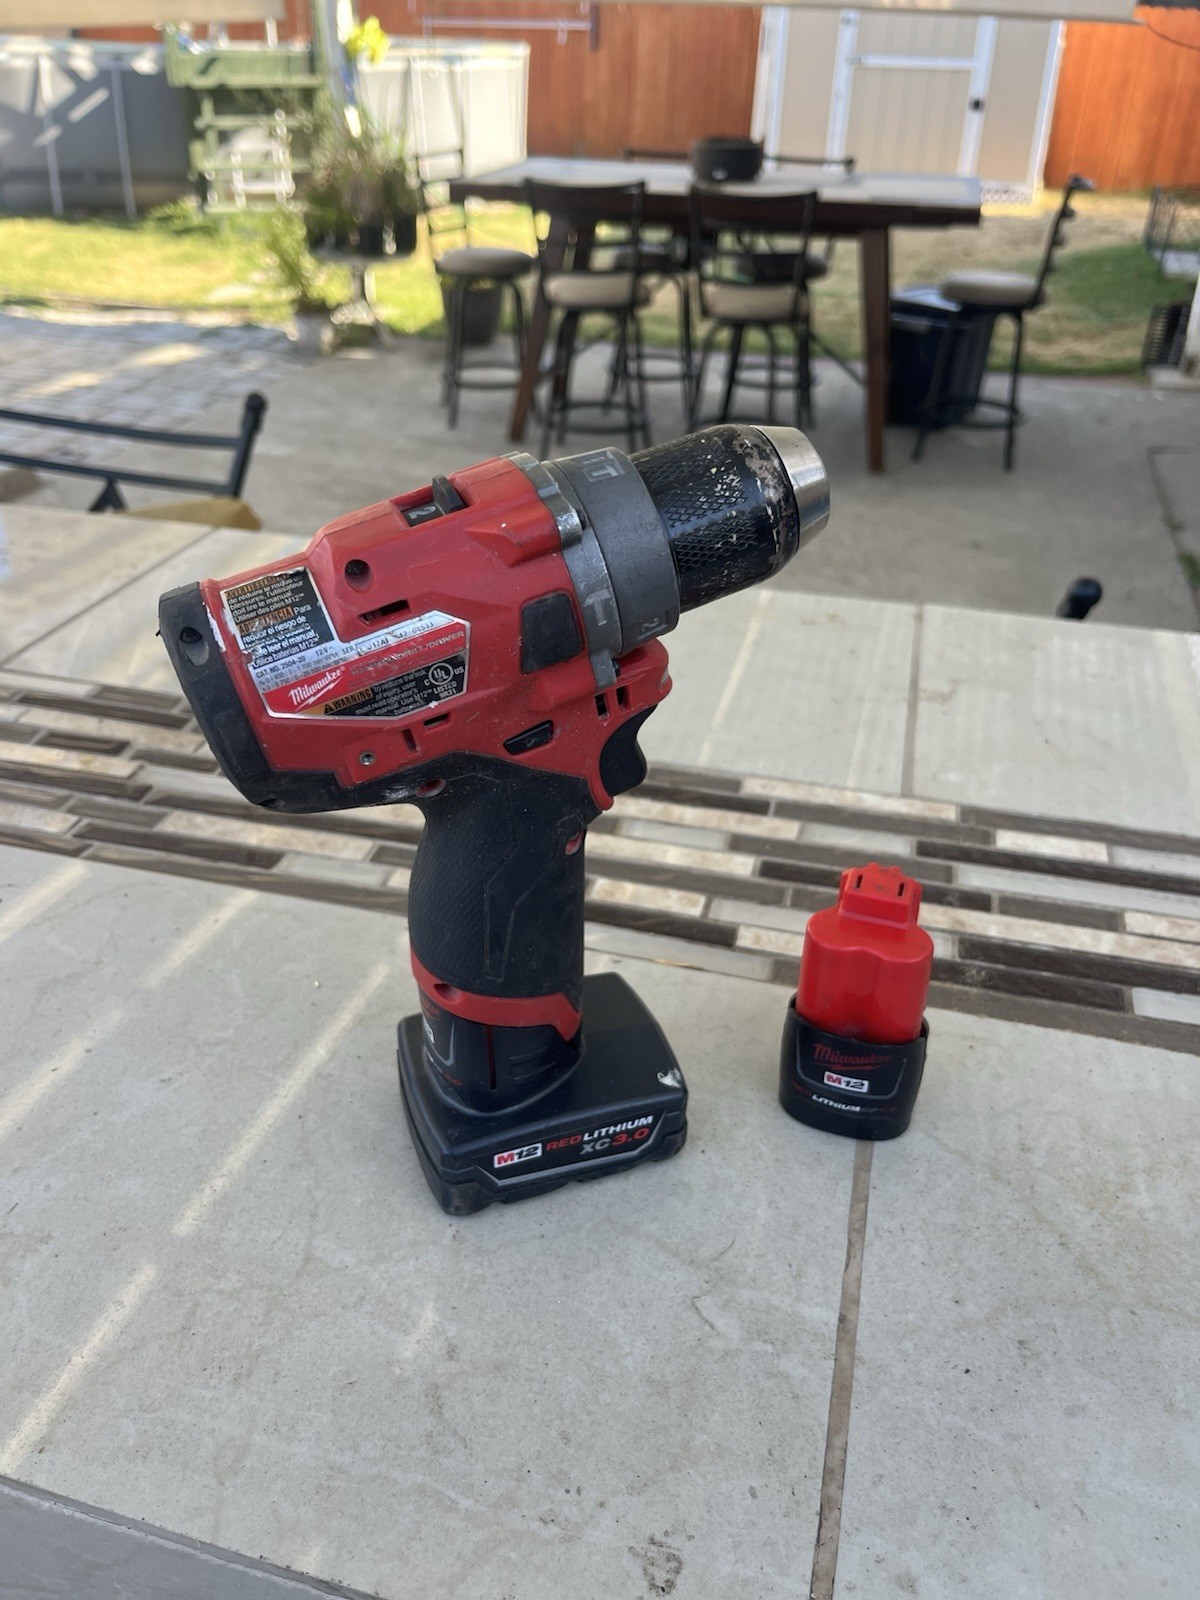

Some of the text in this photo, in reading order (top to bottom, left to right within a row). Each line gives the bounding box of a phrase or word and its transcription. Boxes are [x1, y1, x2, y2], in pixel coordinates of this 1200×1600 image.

[270, 577, 293, 590] risque
[245, 603, 257, 611] lire
[256, 605, 269, 614] des
[269, 600, 285, 610] piles
[292, 602, 311, 615] Para
[242, 614, 306, 644] reducir el riesgo de
[267, 641, 282, 653] leer
[281, 639, 289, 647] el
[269, 665, 279, 673] NO.
[280, 654, 306, 669] 2504-20
[433, 669, 449, 681] UL
[454, 666, 464, 675] US
[288, 669, 342, 705] Milwaukee
[433, 681, 457, 694] LISTED
[333, 689, 371, 709] WARNING
[826, 1074, 865, 1090] M12
[497, 1115, 654, 1165] M12 REDLITHIUM
[580, 1128, 650, 1154] XC 3.0
